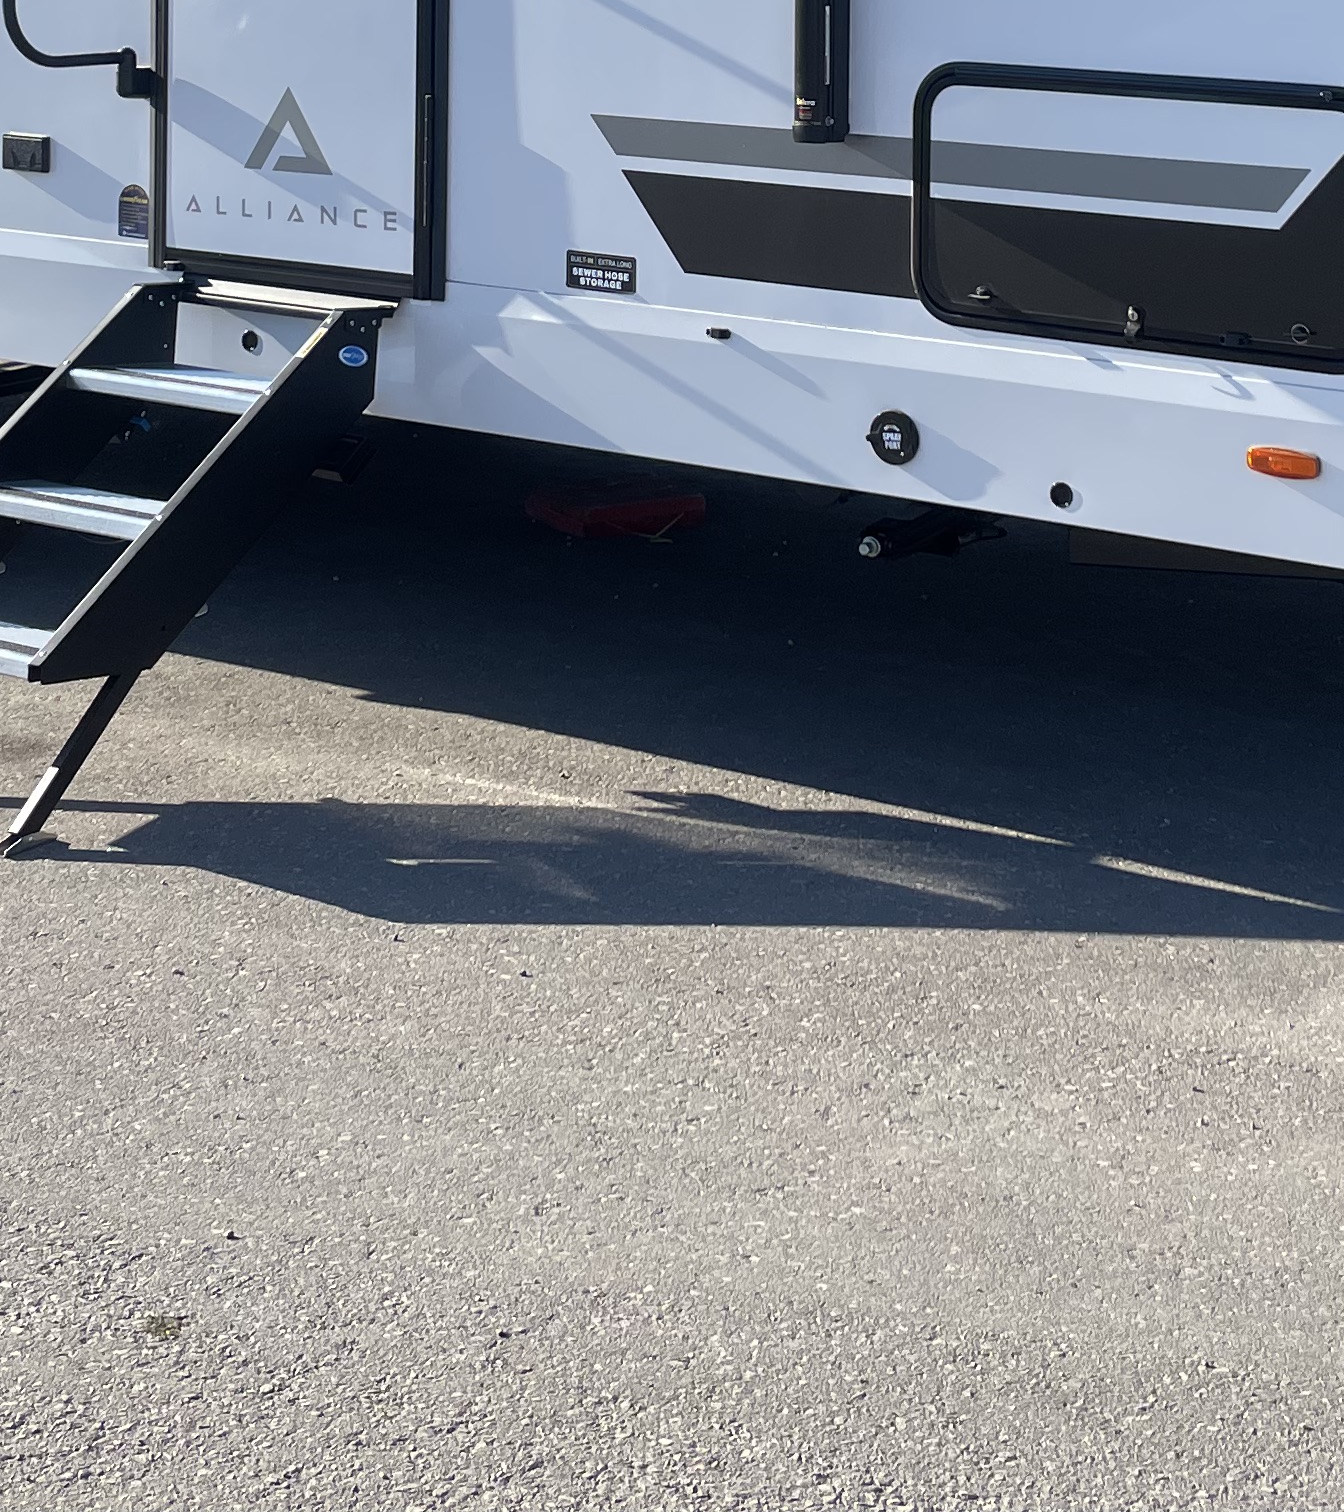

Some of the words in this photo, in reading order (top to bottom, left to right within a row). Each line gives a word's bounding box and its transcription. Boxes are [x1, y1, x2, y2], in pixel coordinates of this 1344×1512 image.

[186, 194, 398, 231] ALLIANCE
[572, 267, 603, 279] SEWER
[605, 271, 630, 282] HOSE
[579, 277, 622, 289] STORAGE
